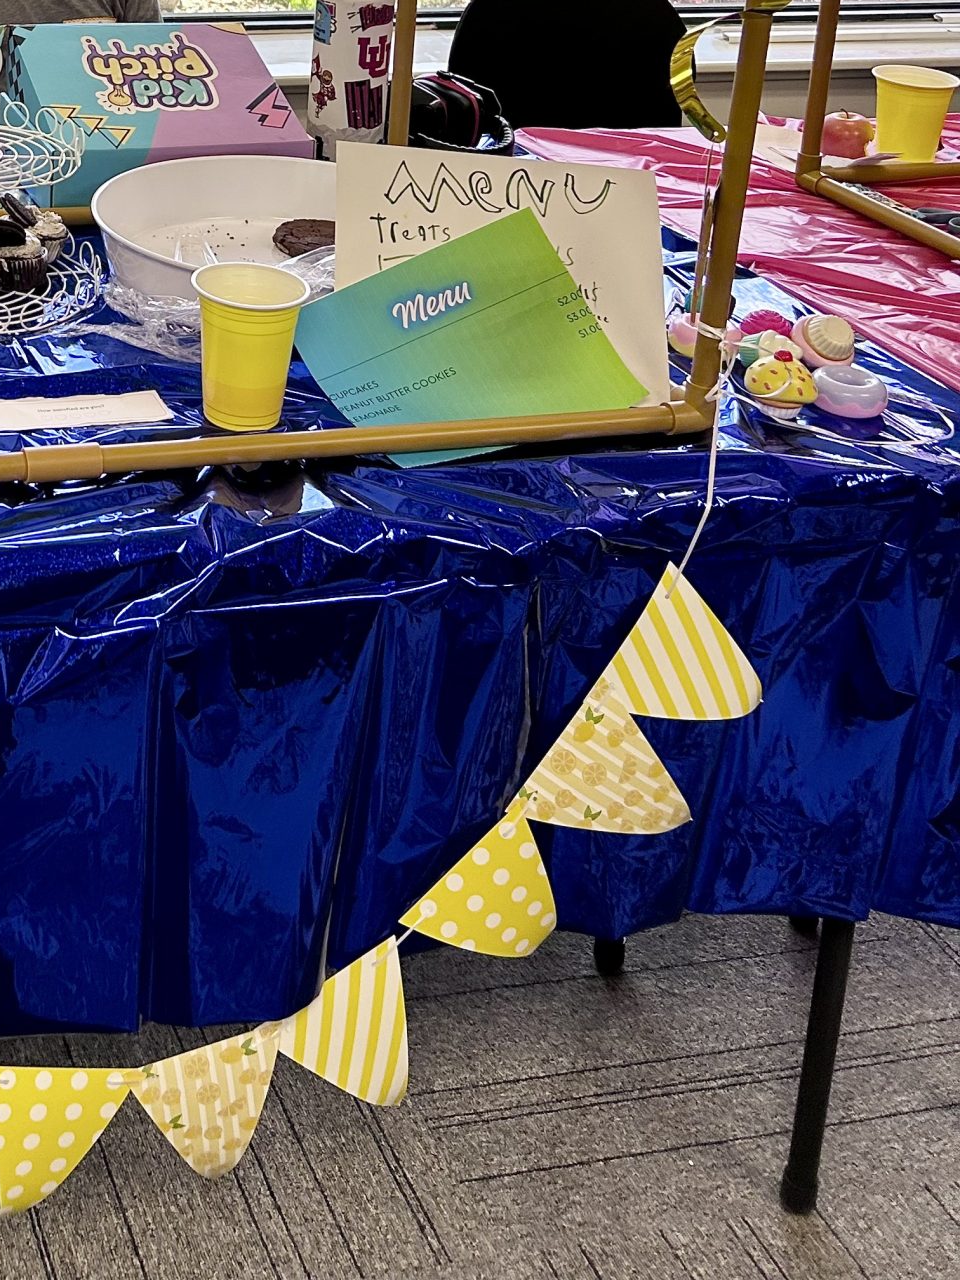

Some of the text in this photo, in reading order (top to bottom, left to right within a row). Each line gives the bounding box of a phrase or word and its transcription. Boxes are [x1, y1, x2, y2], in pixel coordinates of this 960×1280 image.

[91, 47, 210, 86] Pitch
[131, 78, 210, 107] Kid
[392, 281, 472, 329] Menu
[328, 380, 379, 402] CUPCAKES
[339, 366, 457, 414] PEANUT BUTTER COOKIES
